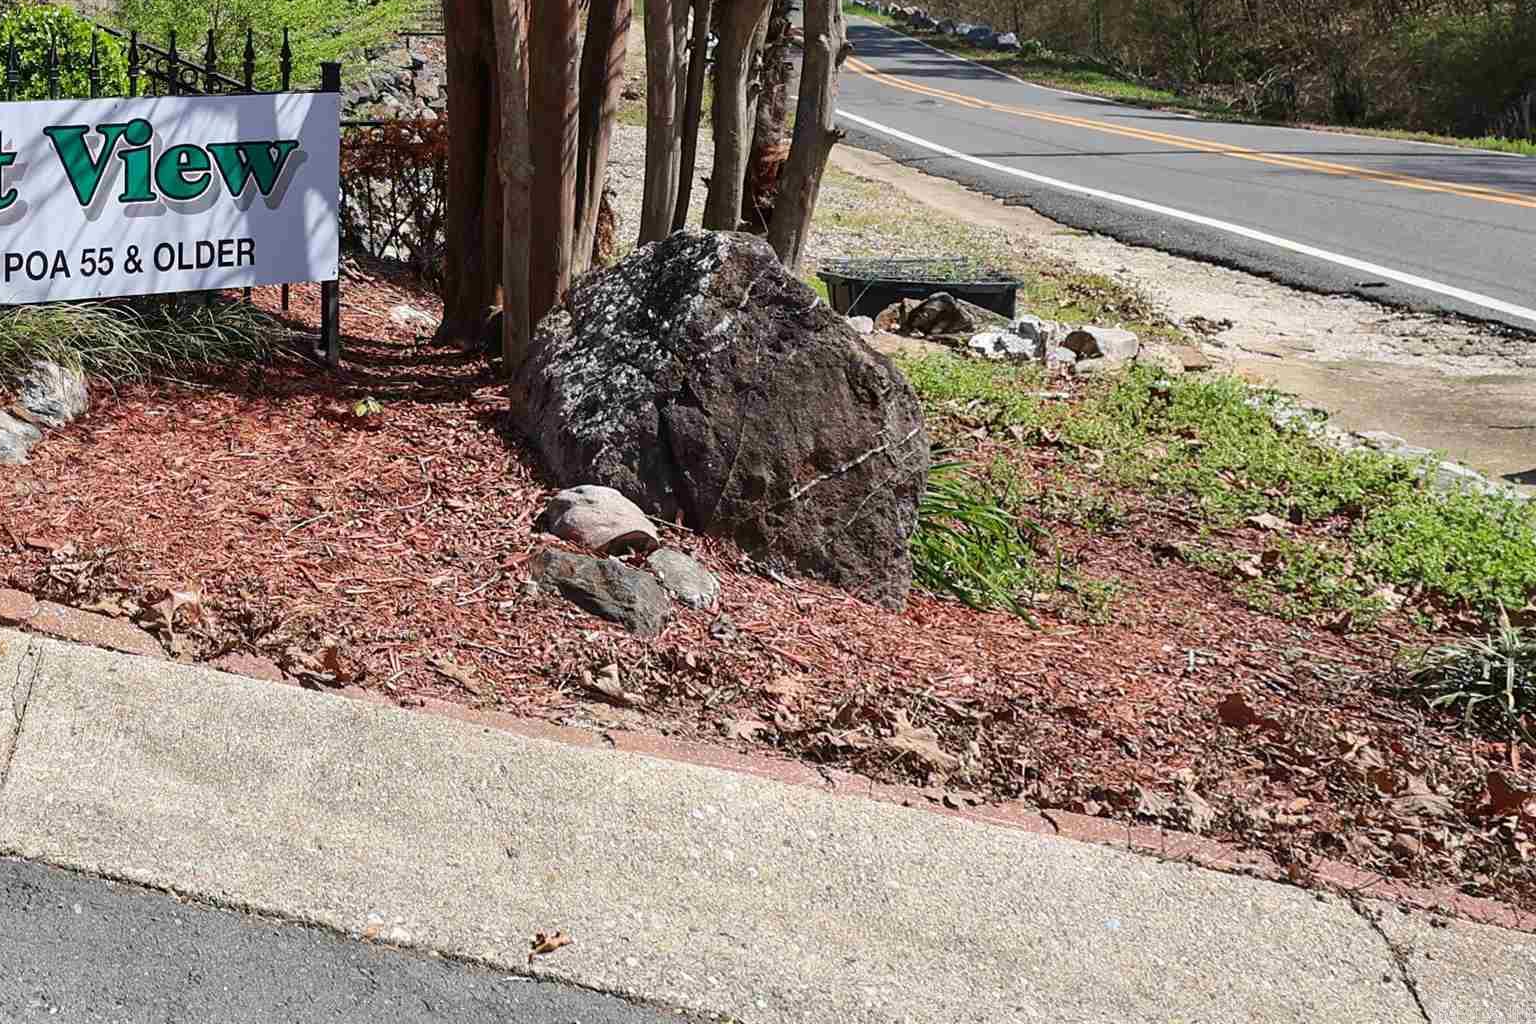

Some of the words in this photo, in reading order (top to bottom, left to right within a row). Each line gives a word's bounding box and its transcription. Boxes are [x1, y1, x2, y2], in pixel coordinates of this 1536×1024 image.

[43, 118, 300, 206] View
[4, 249, 71, 283] POA
[80, 247, 115, 277] 55
[124, 245, 144, 274] &
[154, 238, 256, 272] OLDER
